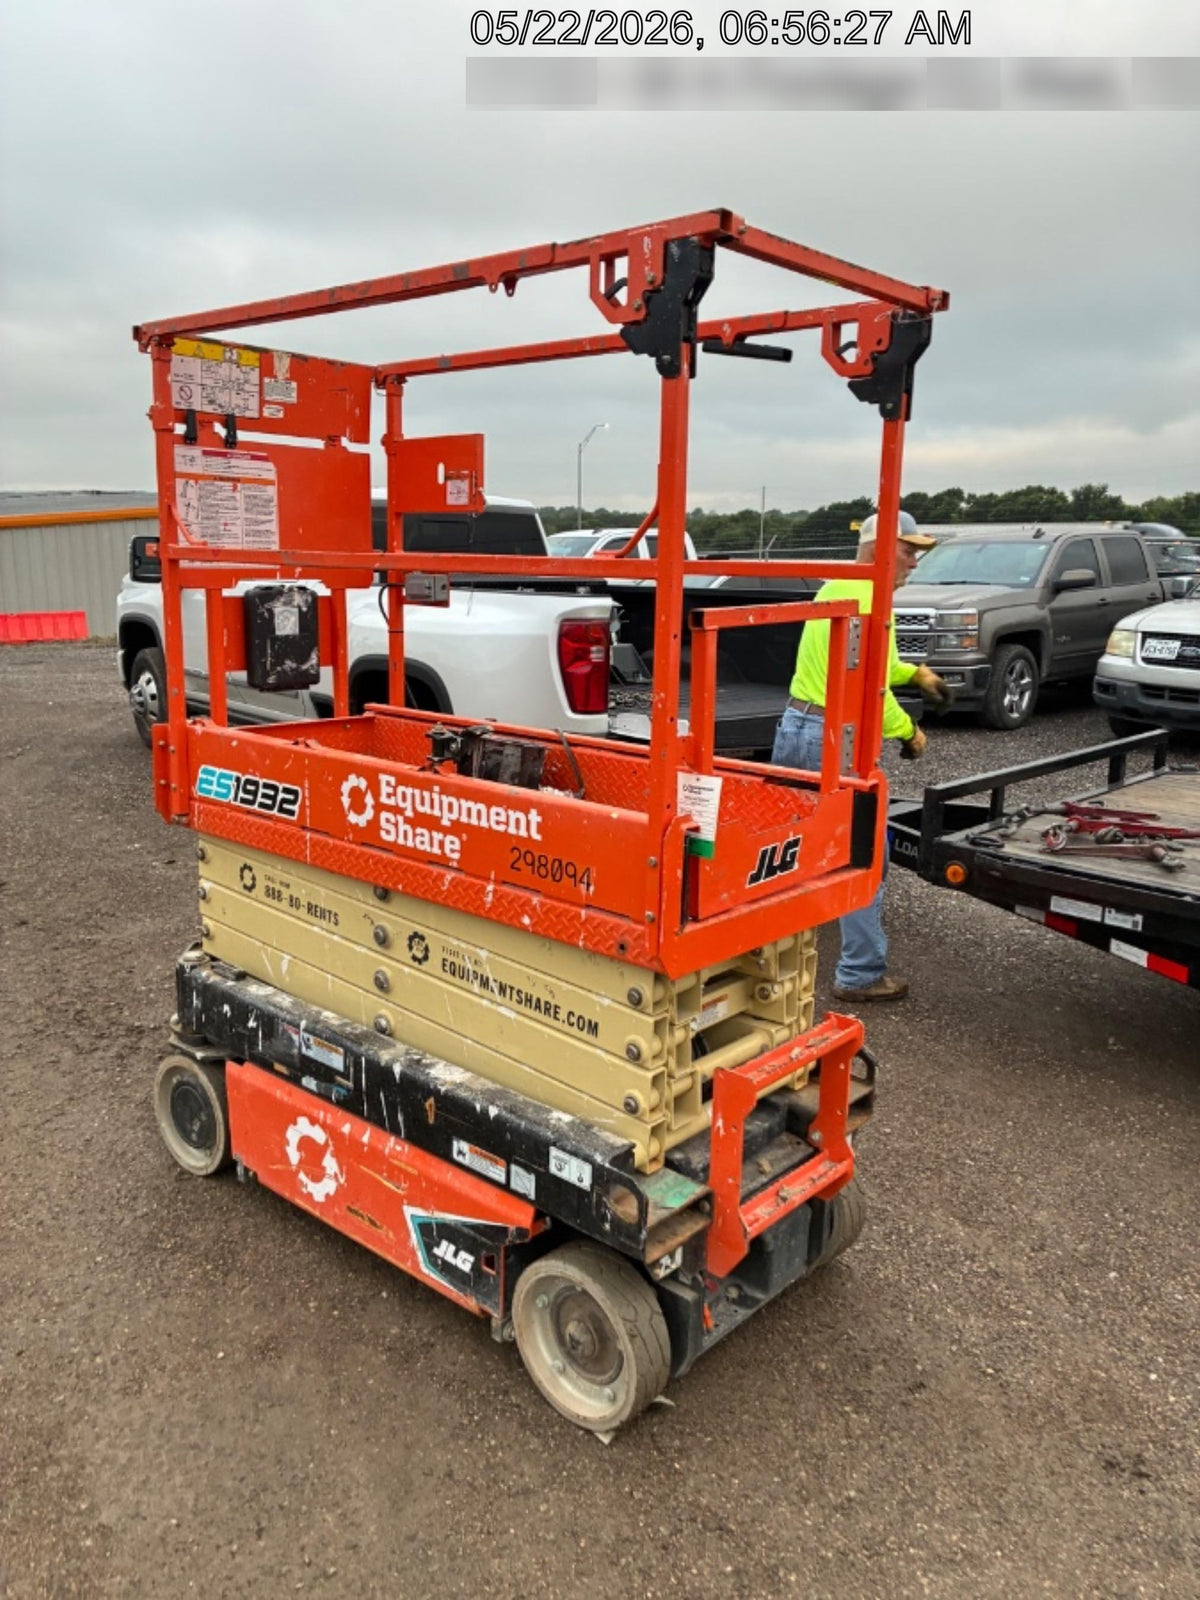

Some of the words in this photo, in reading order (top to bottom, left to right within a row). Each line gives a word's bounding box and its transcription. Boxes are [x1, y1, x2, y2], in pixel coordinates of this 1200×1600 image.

[197, 766, 300, 818] ES1932
[378, 773, 542, 841] Equipment
[379, 811, 461, 860] Share
[510, 846, 592, 892] 298094
[747, 836, 801, 886] JLG
[432, 1238, 475, 1274] JLG
